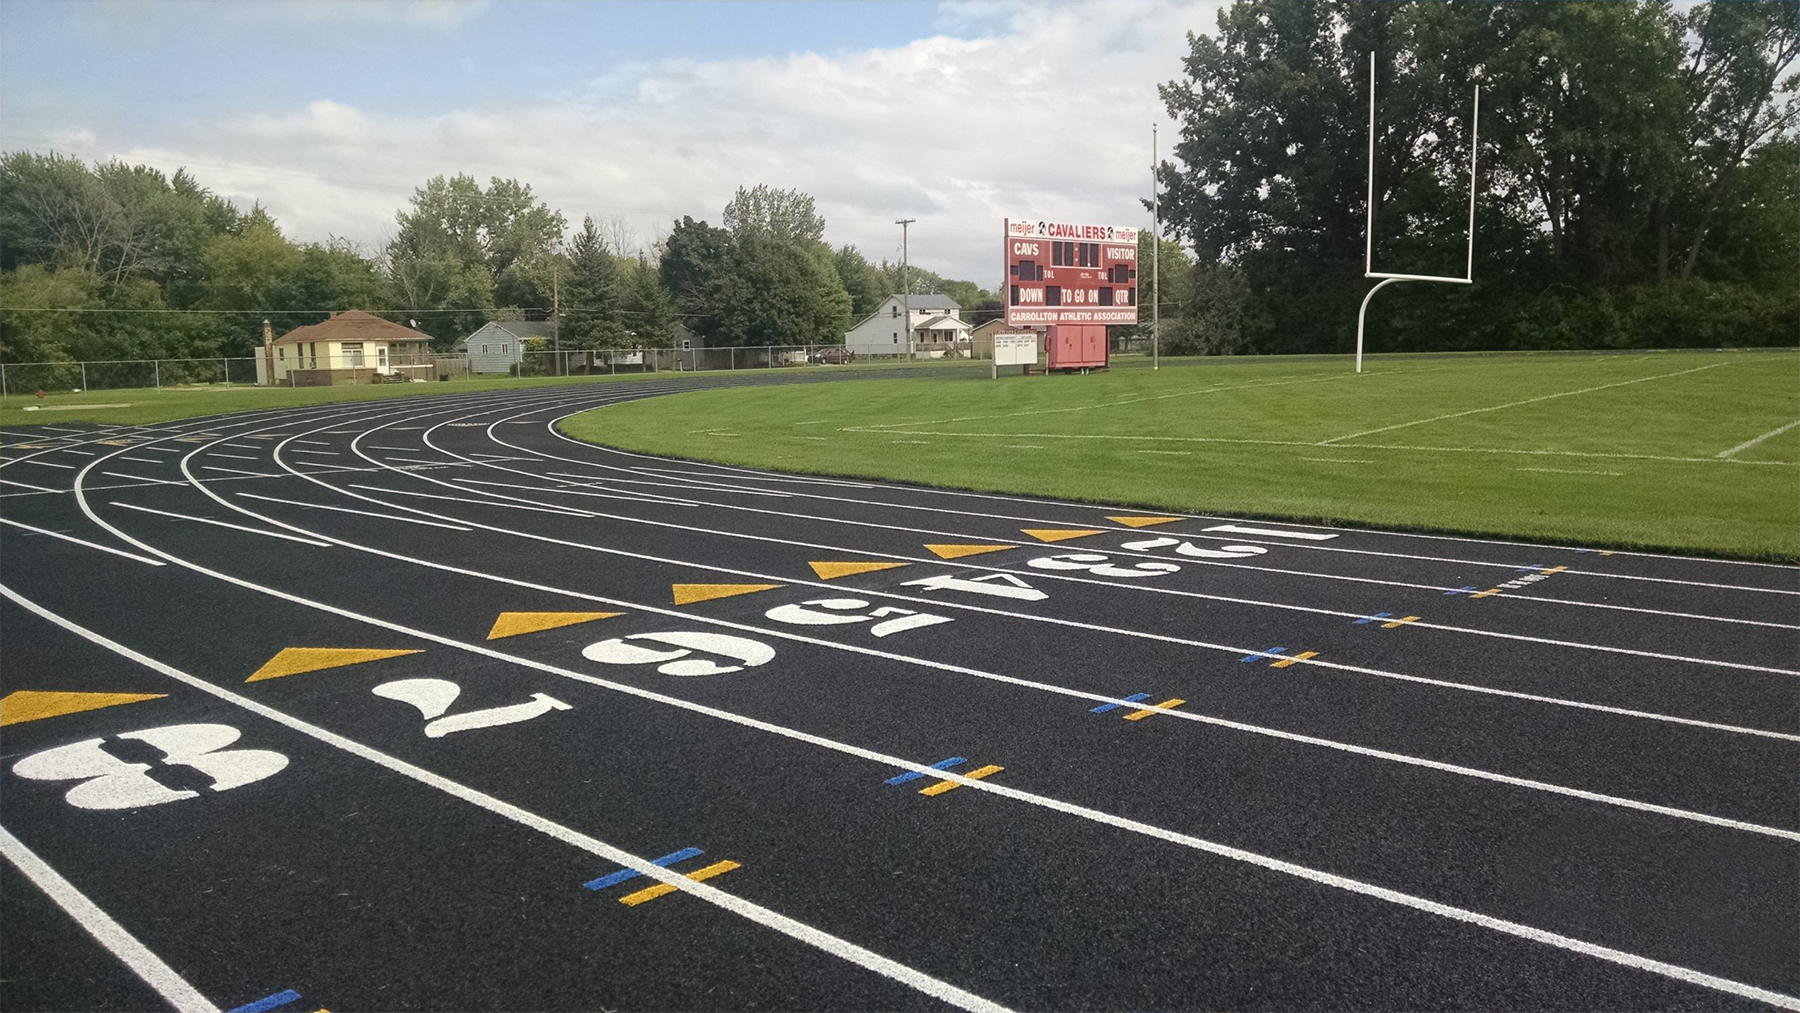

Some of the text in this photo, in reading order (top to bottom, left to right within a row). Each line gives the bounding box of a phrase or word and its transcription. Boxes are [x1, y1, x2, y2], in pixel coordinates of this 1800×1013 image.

[1010, 221, 1035, 236] meijer
[1048, 223, 1106, 240] CAVALIERS
[1115, 228, 1137, 242] meijer
[1014, 242, 1039, 256] CAVS
[1106, 247, 1135, 260] VISITOR
[1044, 270, 1055, 279] TOL
[1098, 271, 1108, 280] TOL
[1020, 288, 1043, 303] DOWN
[1062, 289, 1099, 303] TO GO ON
[1115, 289, 1129, 304] QTR
[1010, 311, 1136, 321] CARROLLTON ATHLETIC ASSOCIATION
[1120, 536, 1268, 559] 2
[1026, 553, 1182, 578] 3
[900, 572, 1049, 601] 4
[764, 598, 955, 638] 5
[581, 630, 777, 677] 6
[371, 677, 574, 739] 7
[12, 722, 291, 811] 8
